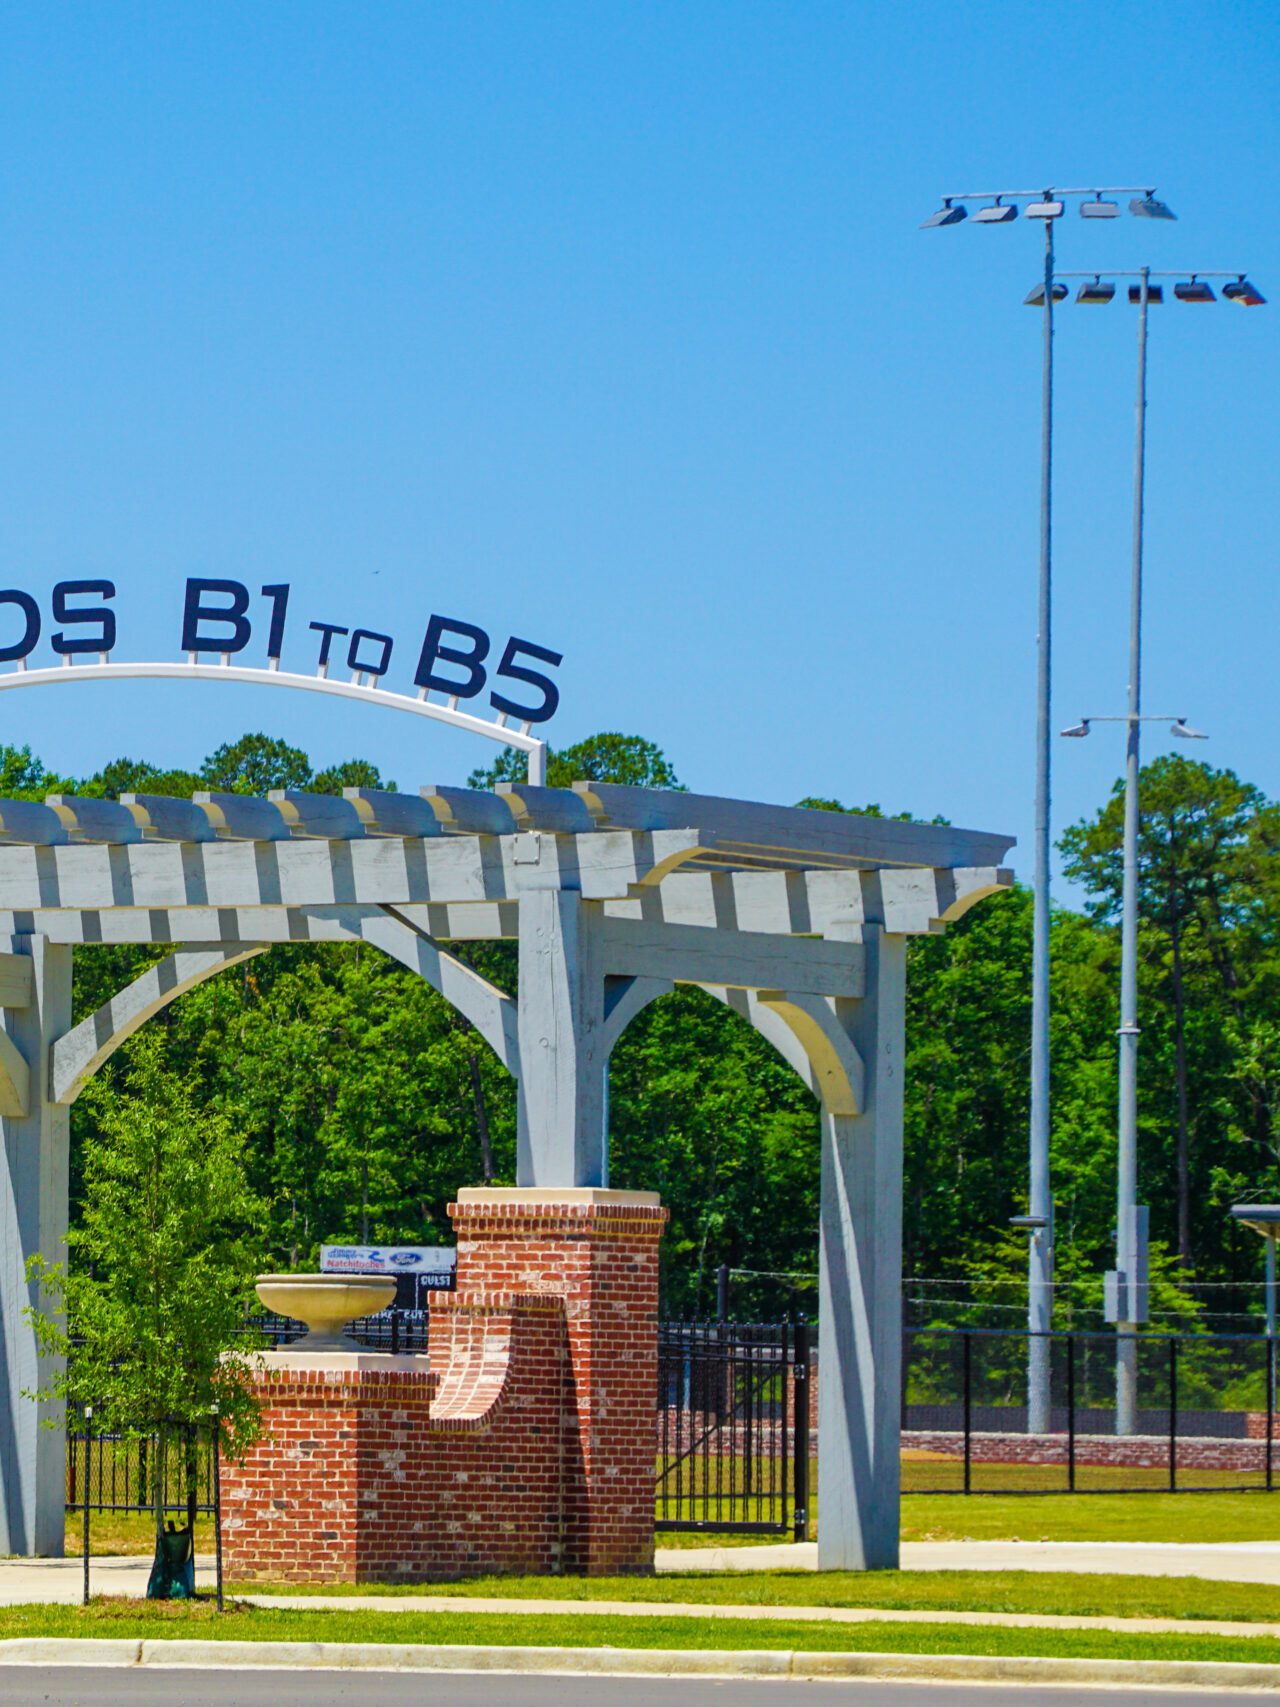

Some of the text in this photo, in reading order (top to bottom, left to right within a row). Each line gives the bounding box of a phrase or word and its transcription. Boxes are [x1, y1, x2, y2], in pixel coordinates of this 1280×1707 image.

[181, 577, 290, 659] B1
[308, 621, 394, 676] TO
[413, 614, 564, 724] B5
